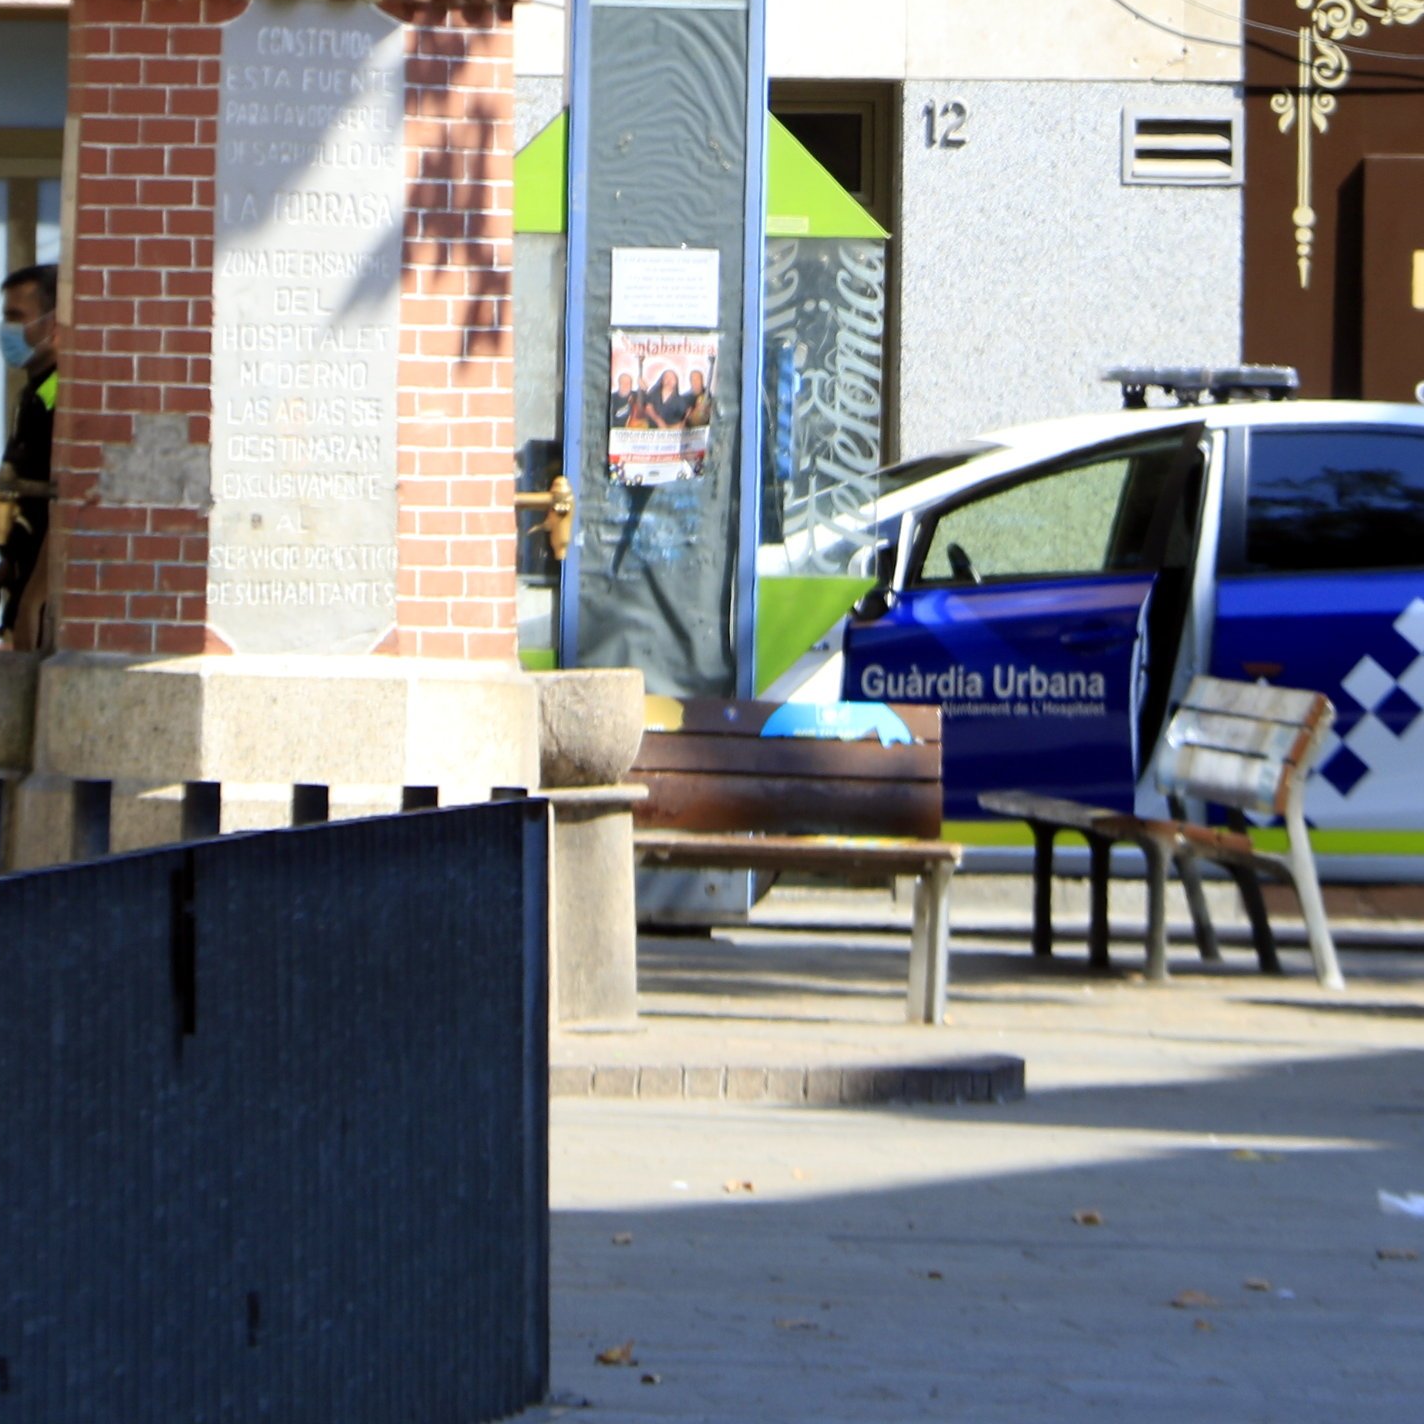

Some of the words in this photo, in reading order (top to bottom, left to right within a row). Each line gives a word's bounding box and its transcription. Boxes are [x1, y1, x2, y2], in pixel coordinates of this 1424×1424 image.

[227, 67, 290, 91] ESTA
[302, 68, 394, 97] FUENTE
[921, 99, 968, 149] 12
[223, 193, 259, 225] LA
[274, 190, 395, 227] TORRASA
[222, 248, 269, 278] ZONA
[275, 287, 335, 316] DEL
[222, 324, 391, 353] HOSPITALET
[240, 360, 369, 390] MODERNO
[226, 397, 271, 425] LAS
[277, 396, 346, 426] AGUAS
[227, 433, 381, 463] DESTINARAN
[276, 510, 308, 534] AL
[860, 663, 983, 701] Guàrdia
[993, 664, 1106, 701] Urbana
